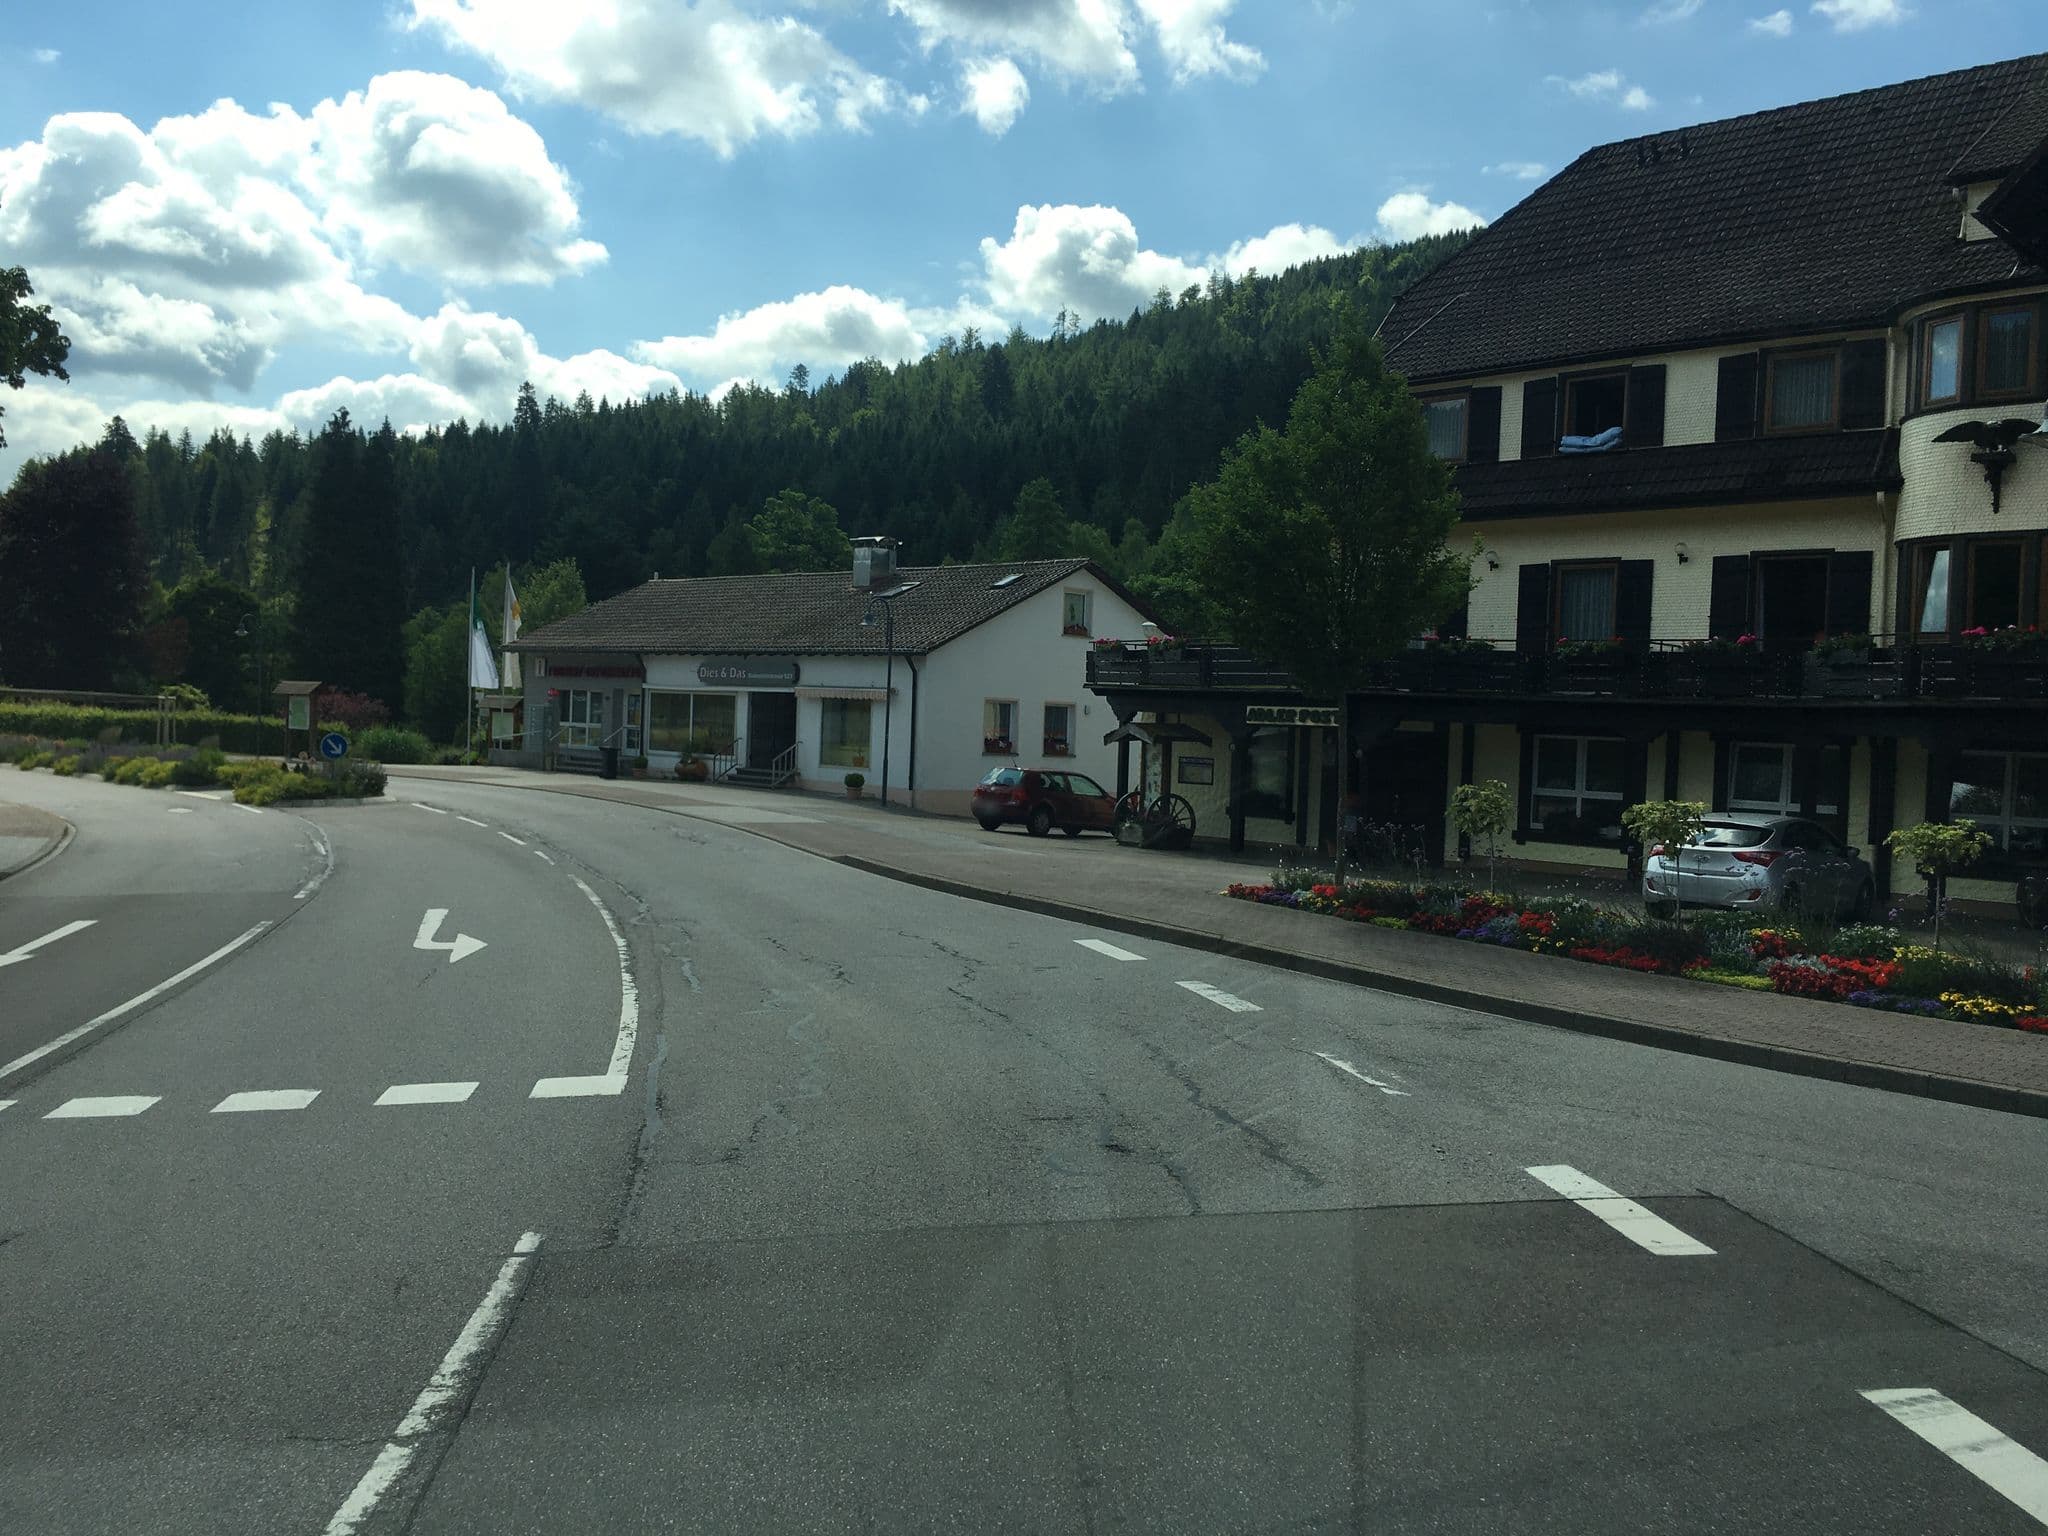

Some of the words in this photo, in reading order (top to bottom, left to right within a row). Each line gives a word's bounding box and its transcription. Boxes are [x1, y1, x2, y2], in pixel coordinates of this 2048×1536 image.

[700, 667, 718, 678] Dies
[720, 667, 727, 678] &
[730, 667, 746, 679] Das
